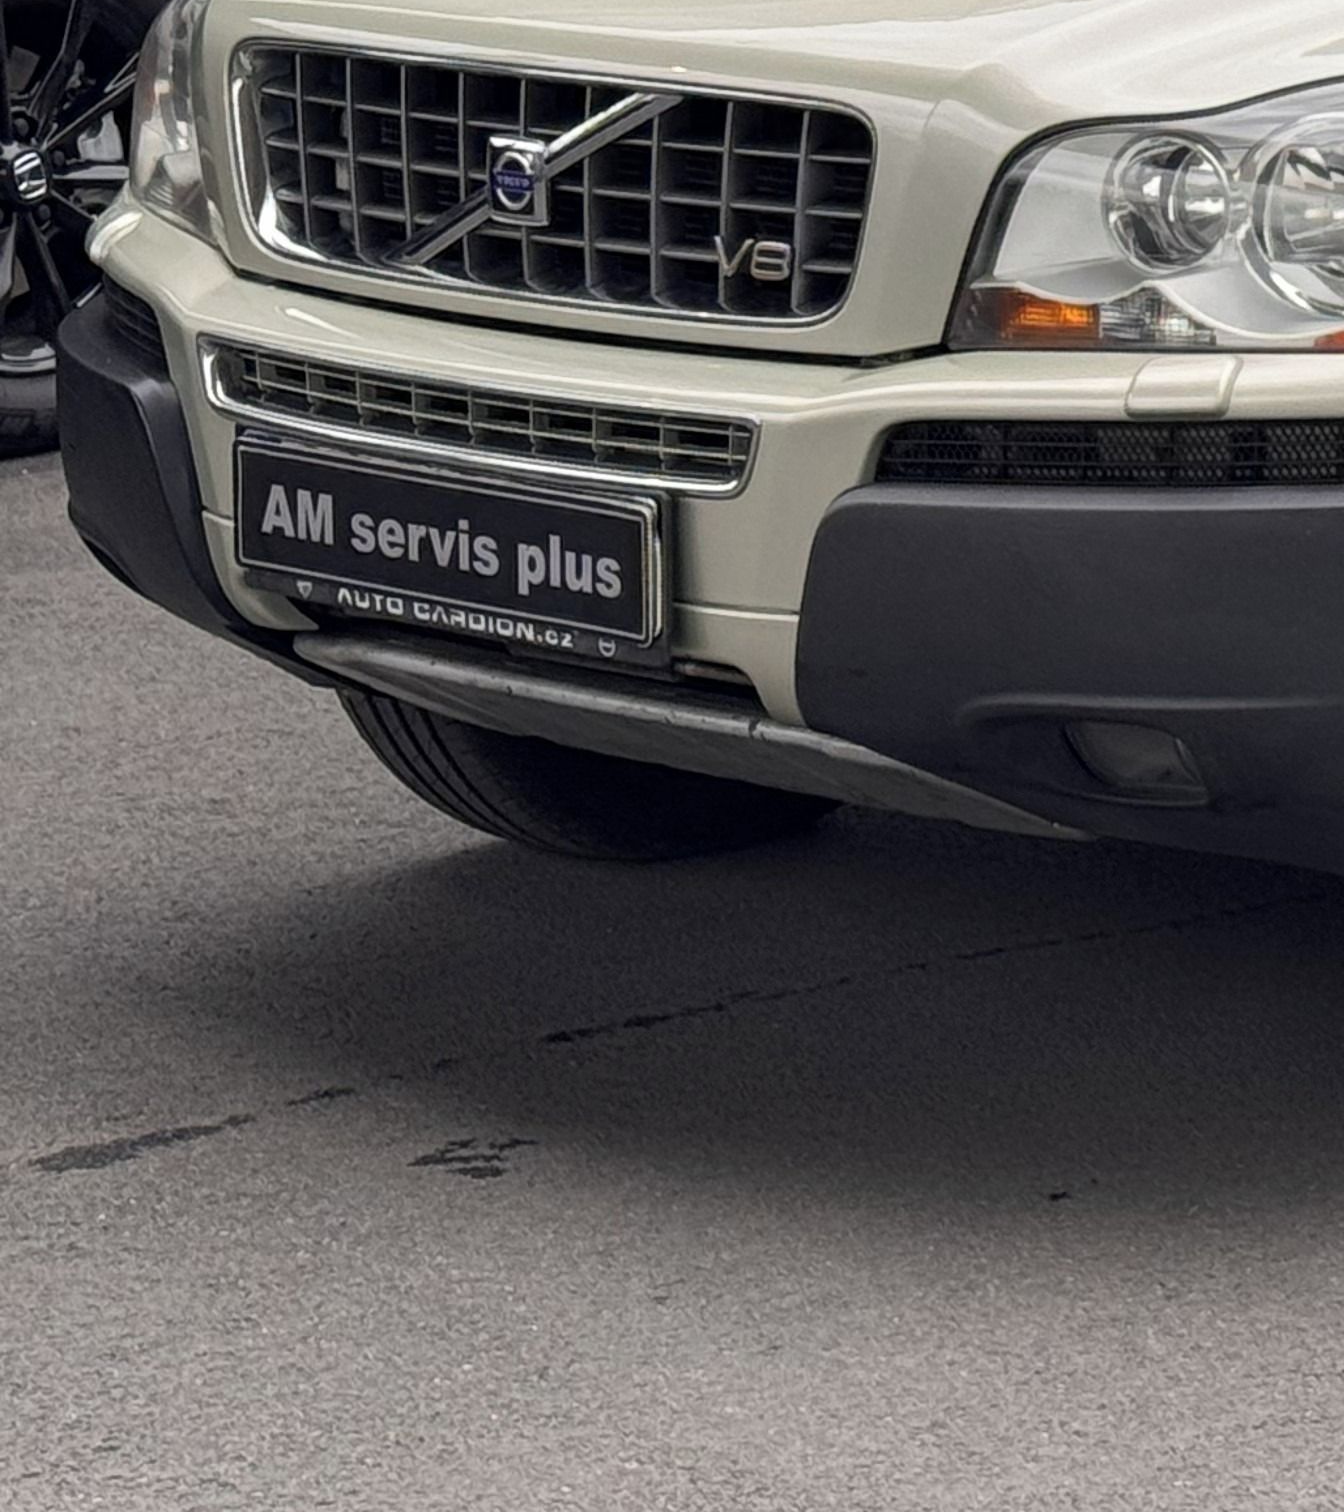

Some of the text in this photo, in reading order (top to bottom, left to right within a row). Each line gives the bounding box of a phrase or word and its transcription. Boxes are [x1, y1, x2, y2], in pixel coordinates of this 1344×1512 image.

[713, 235, 792, 282] V8
[261, 483, 623, 599] AM servis plus
[337, 586, 405, 617] AUTO
